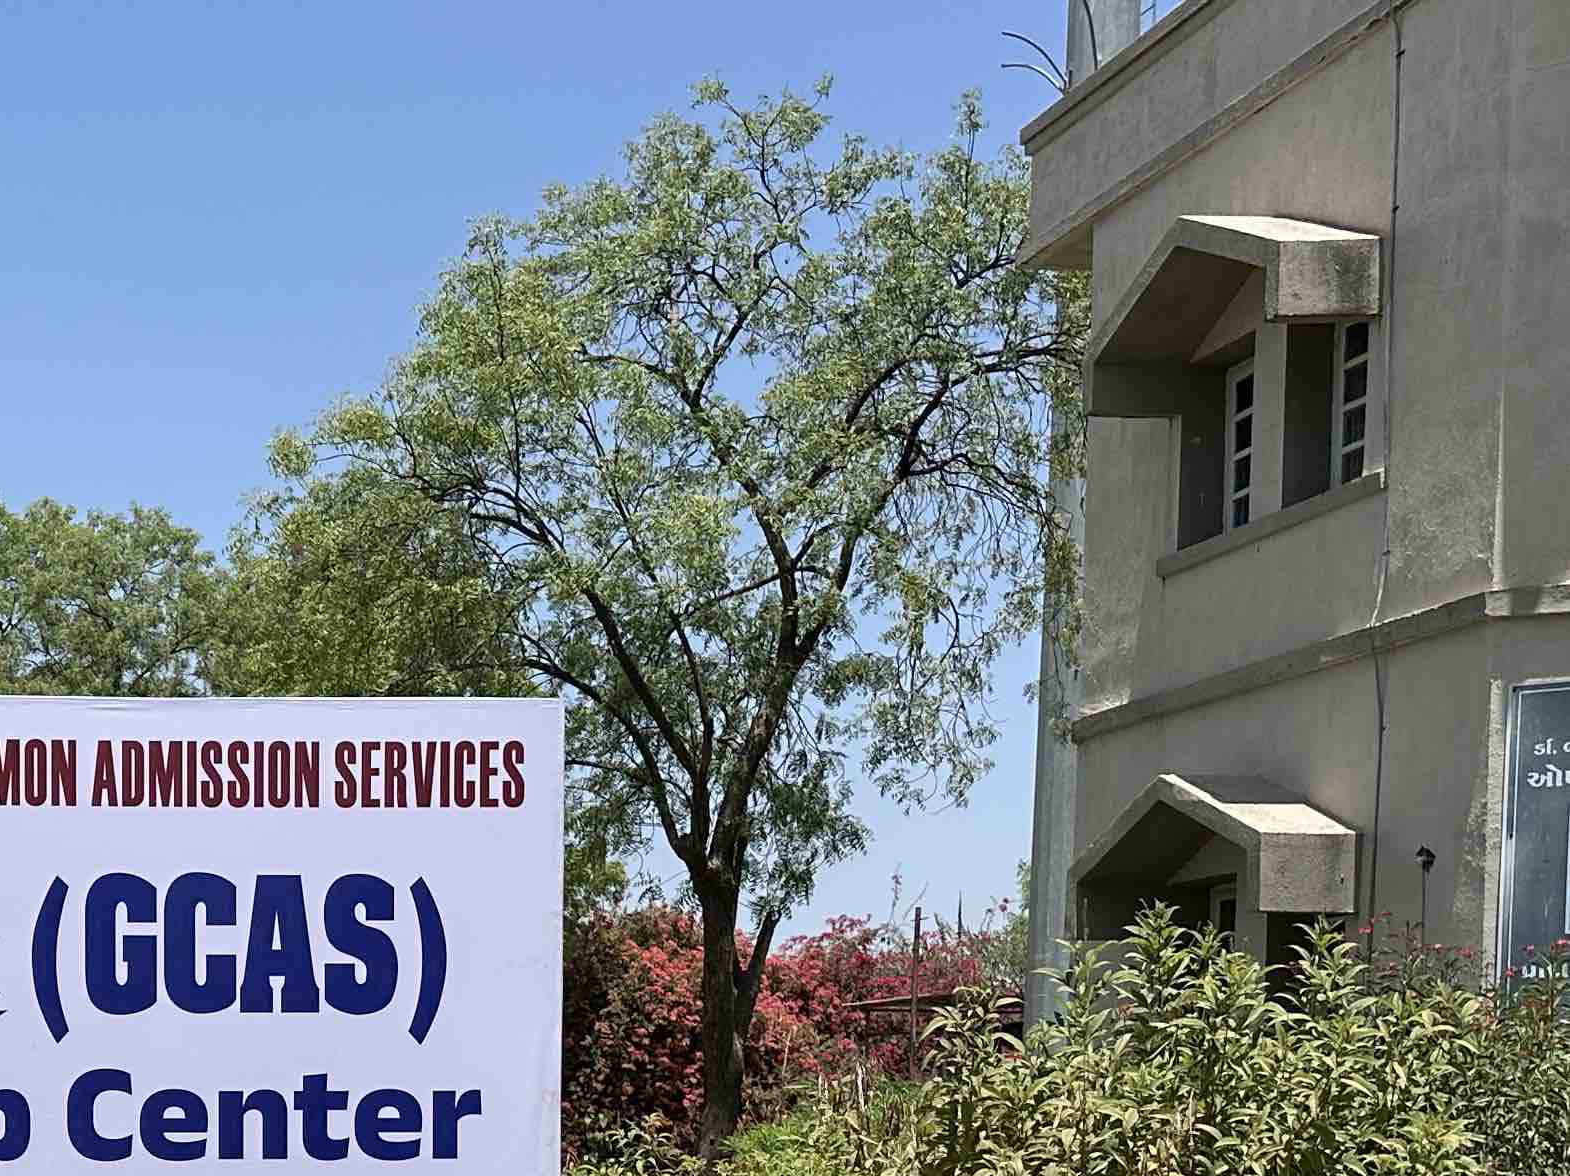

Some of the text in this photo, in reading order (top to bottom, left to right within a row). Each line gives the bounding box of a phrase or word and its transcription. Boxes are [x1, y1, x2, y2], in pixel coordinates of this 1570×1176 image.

[92, 740, 319, 808] ADMISSION
[335, 741, 524, 808] SERVICES
[32, 872, 447, 1045] (GCAS)
[67, 1069, 482, 1161] Center
